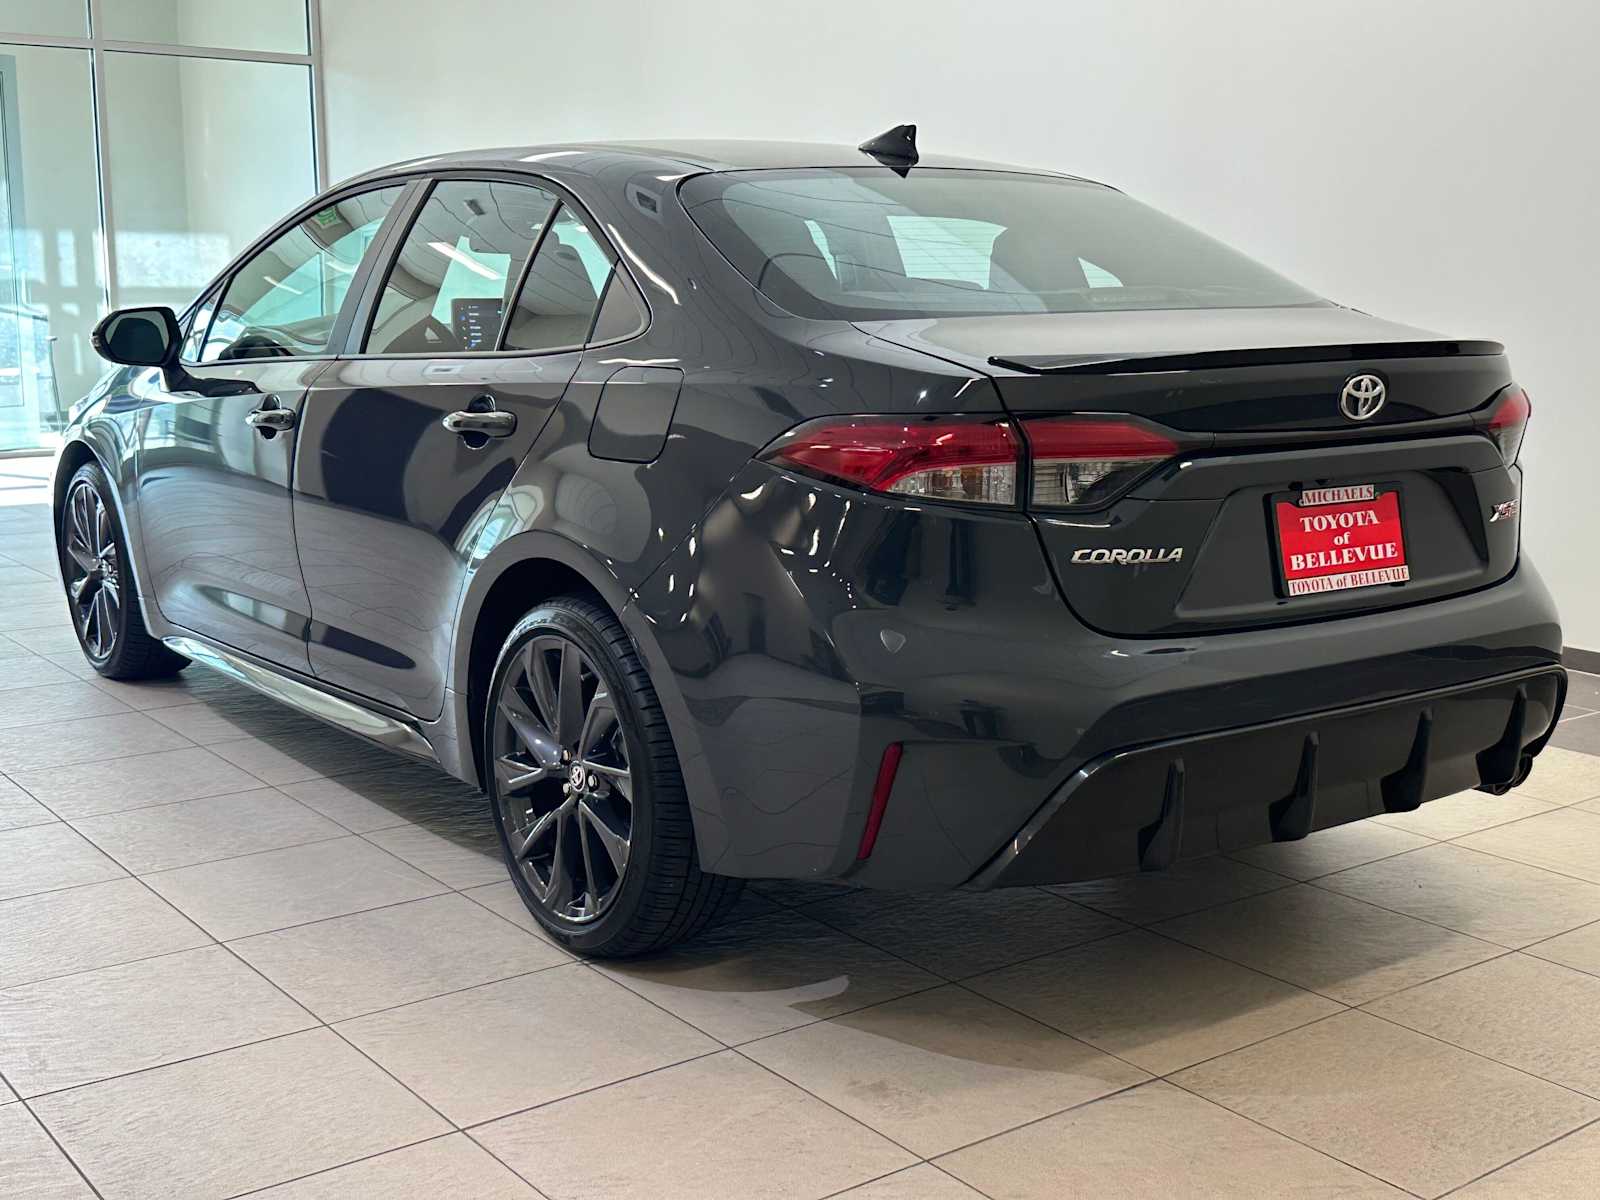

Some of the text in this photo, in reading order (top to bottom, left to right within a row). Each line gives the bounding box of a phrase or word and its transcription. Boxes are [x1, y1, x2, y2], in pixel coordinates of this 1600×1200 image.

[1303, 486, 1374, 504] MICHAELS
[1300, 510, 1379, 532] TOYOTA
[1333, 531, 1350, 546] of
[1071, 547, 1183, 565] COROLLA
[1290, 542, 1398, 571] BELLEVUE
[1290, 567, 1408, 594] TOYOTA of BELLEVUE
